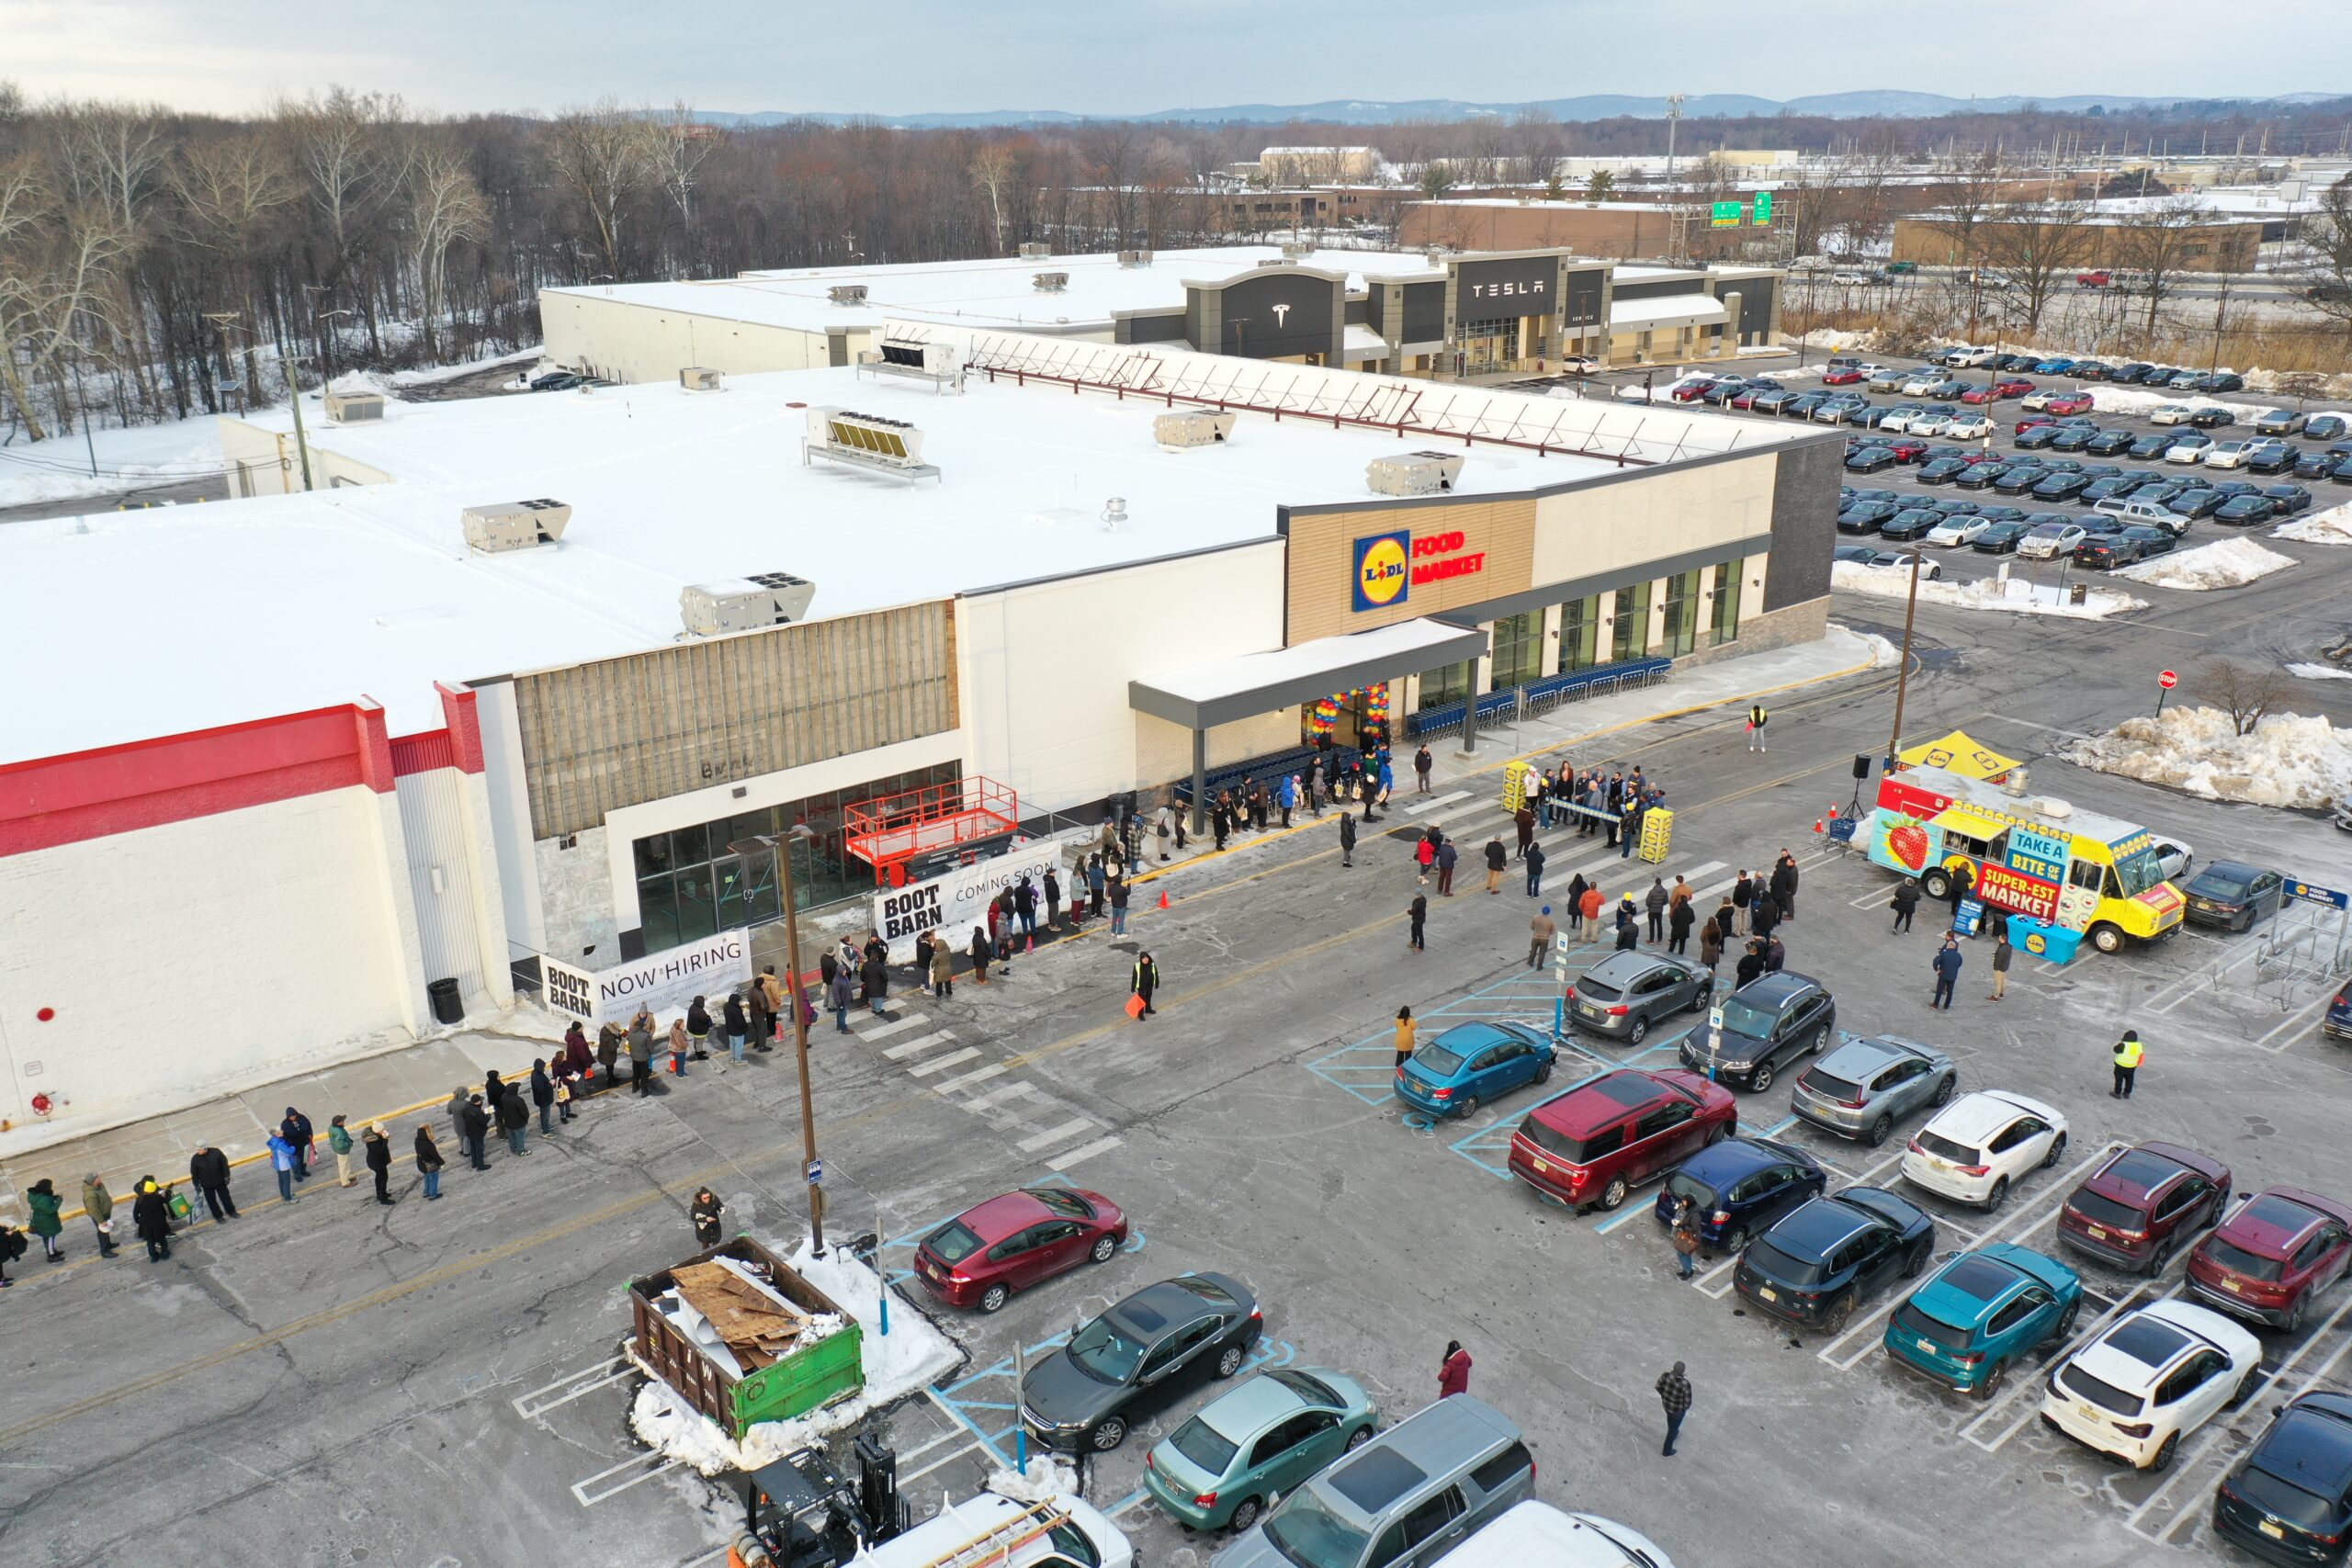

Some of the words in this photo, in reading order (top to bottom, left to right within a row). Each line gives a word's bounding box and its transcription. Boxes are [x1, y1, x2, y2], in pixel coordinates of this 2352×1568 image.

[1472, 280, 1544, 298] TESLA
[1572, 314, 1594, 322] SERICE
[1412, 531, 1464, 558] FOOD
[1411, 553, 1485, 586] MARKET
[2160, 675, 2177, 683] STOP
[2017, 834, 2051, 855] TAKE
[2052, 845, 2063, 859] A
[2011, 853, 2046, 875] BITE
[2047, 865, 2061, 874] OF
[2047, 873, 2059, 881] THE
[956, 874, 1010, 902] COMING
[1015, 861, 1054, 883] SOON
[1984, 869, 2056, 901] SUPER-EST
[2309, 887, 2327, 896] FOOD
[884, 884, 939, 919] BOOT
[1981, 882, 2053, 917] MARKET
[2308, 893, 2335, 902] MARKET
[886, 905, 943, 941] BARN
[548, 965, 589, 998] BOOT
[601, 967, 656, 1000] NOW
[665, 942, 741, 980] HIRING
[549, 986, 593, 1018] BARN
